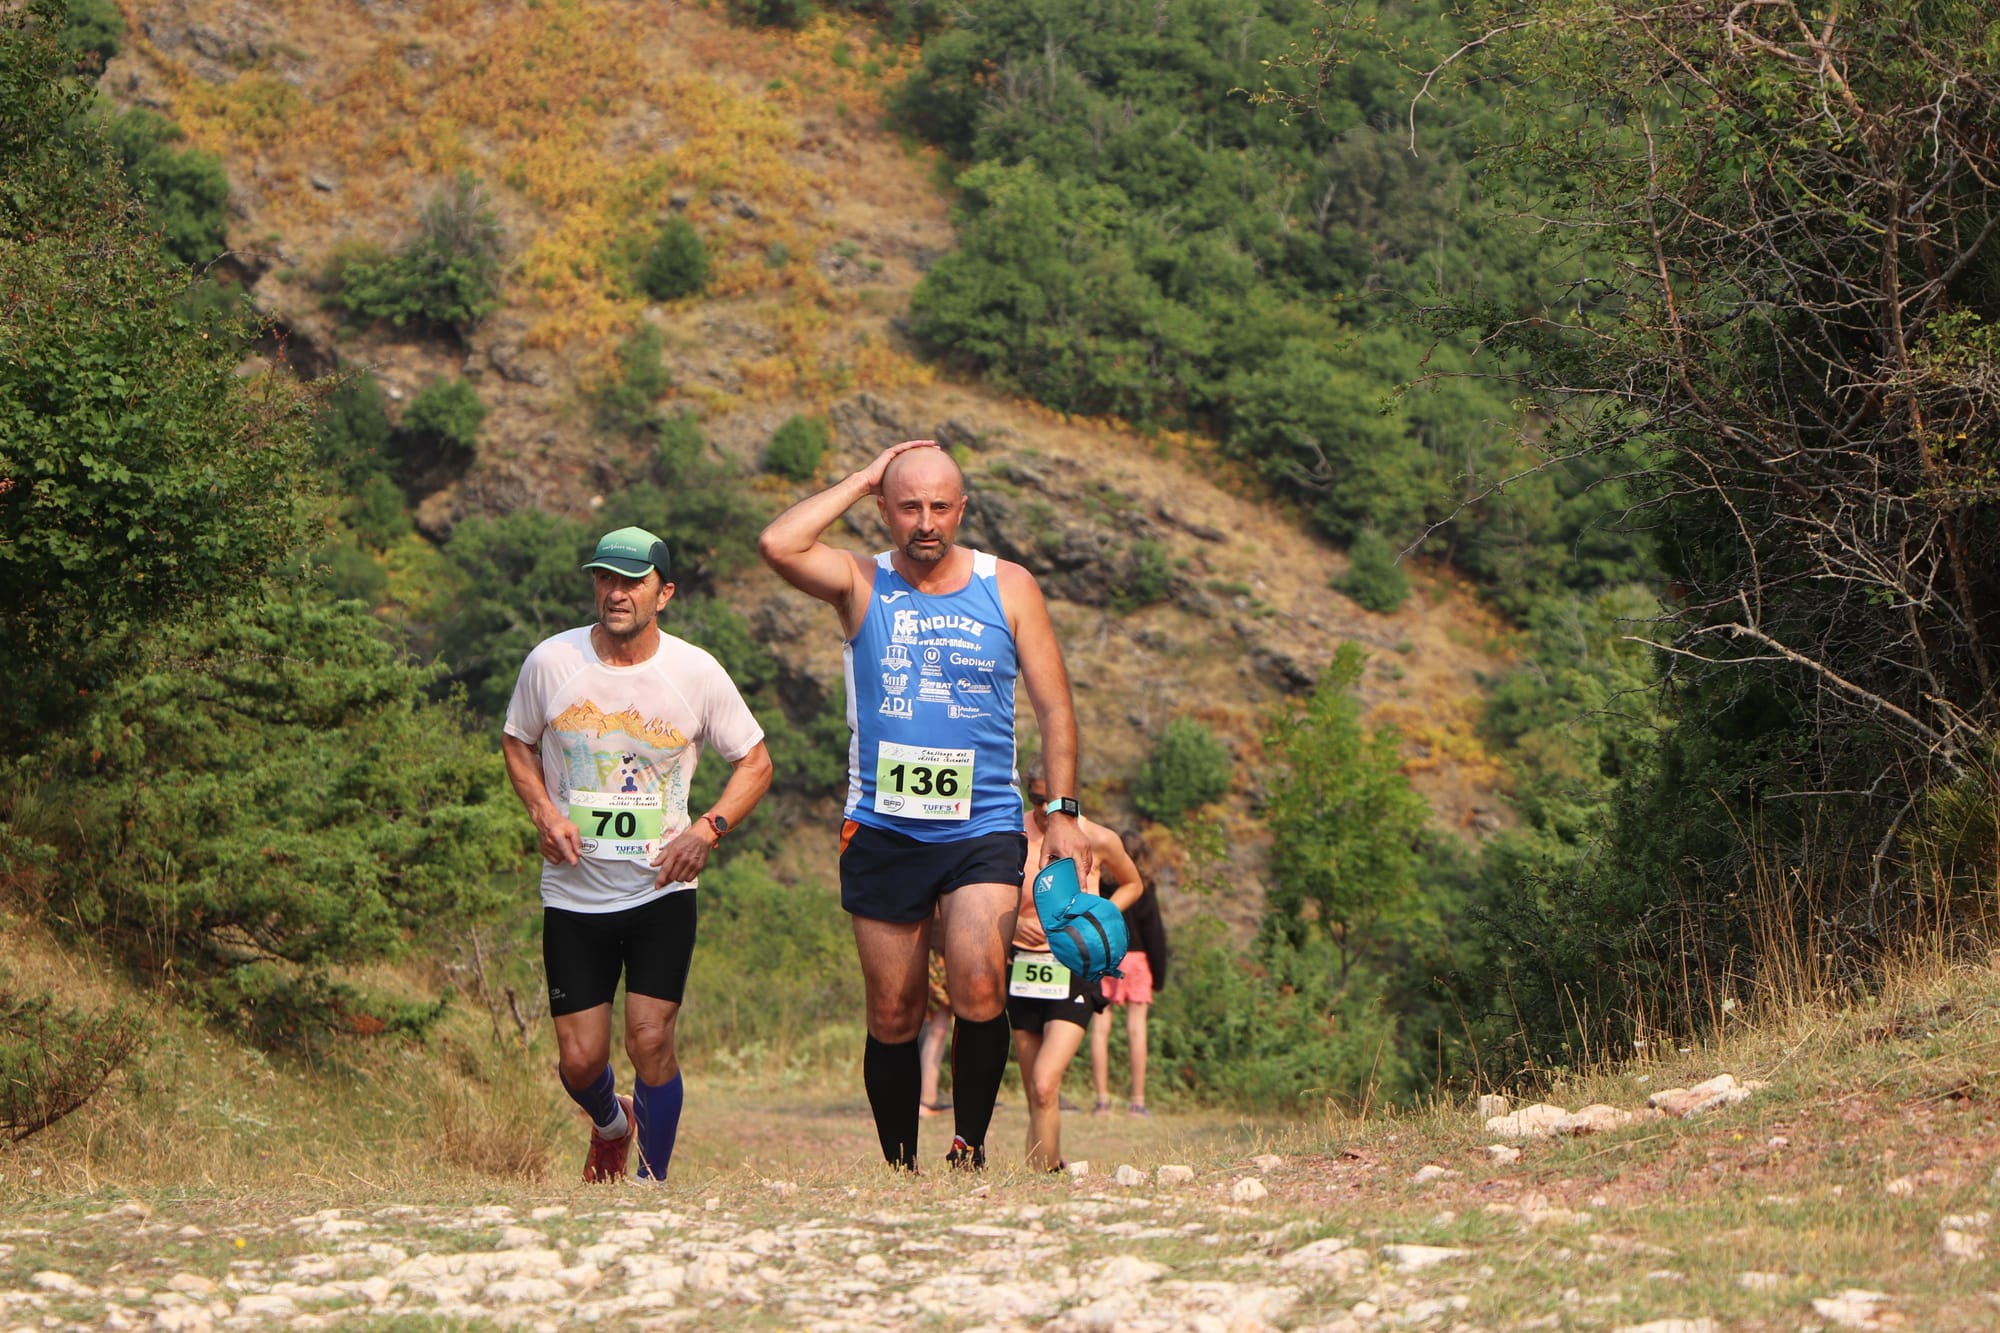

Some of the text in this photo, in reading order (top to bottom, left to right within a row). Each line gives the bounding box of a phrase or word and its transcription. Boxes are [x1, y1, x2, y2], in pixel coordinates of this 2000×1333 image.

[889, 764, 959, 797] 136
[922, 803, 952, 811] TUFF'S
[591, 810, 637, 838] 70
[1025, 964, 1053, 982] 56
